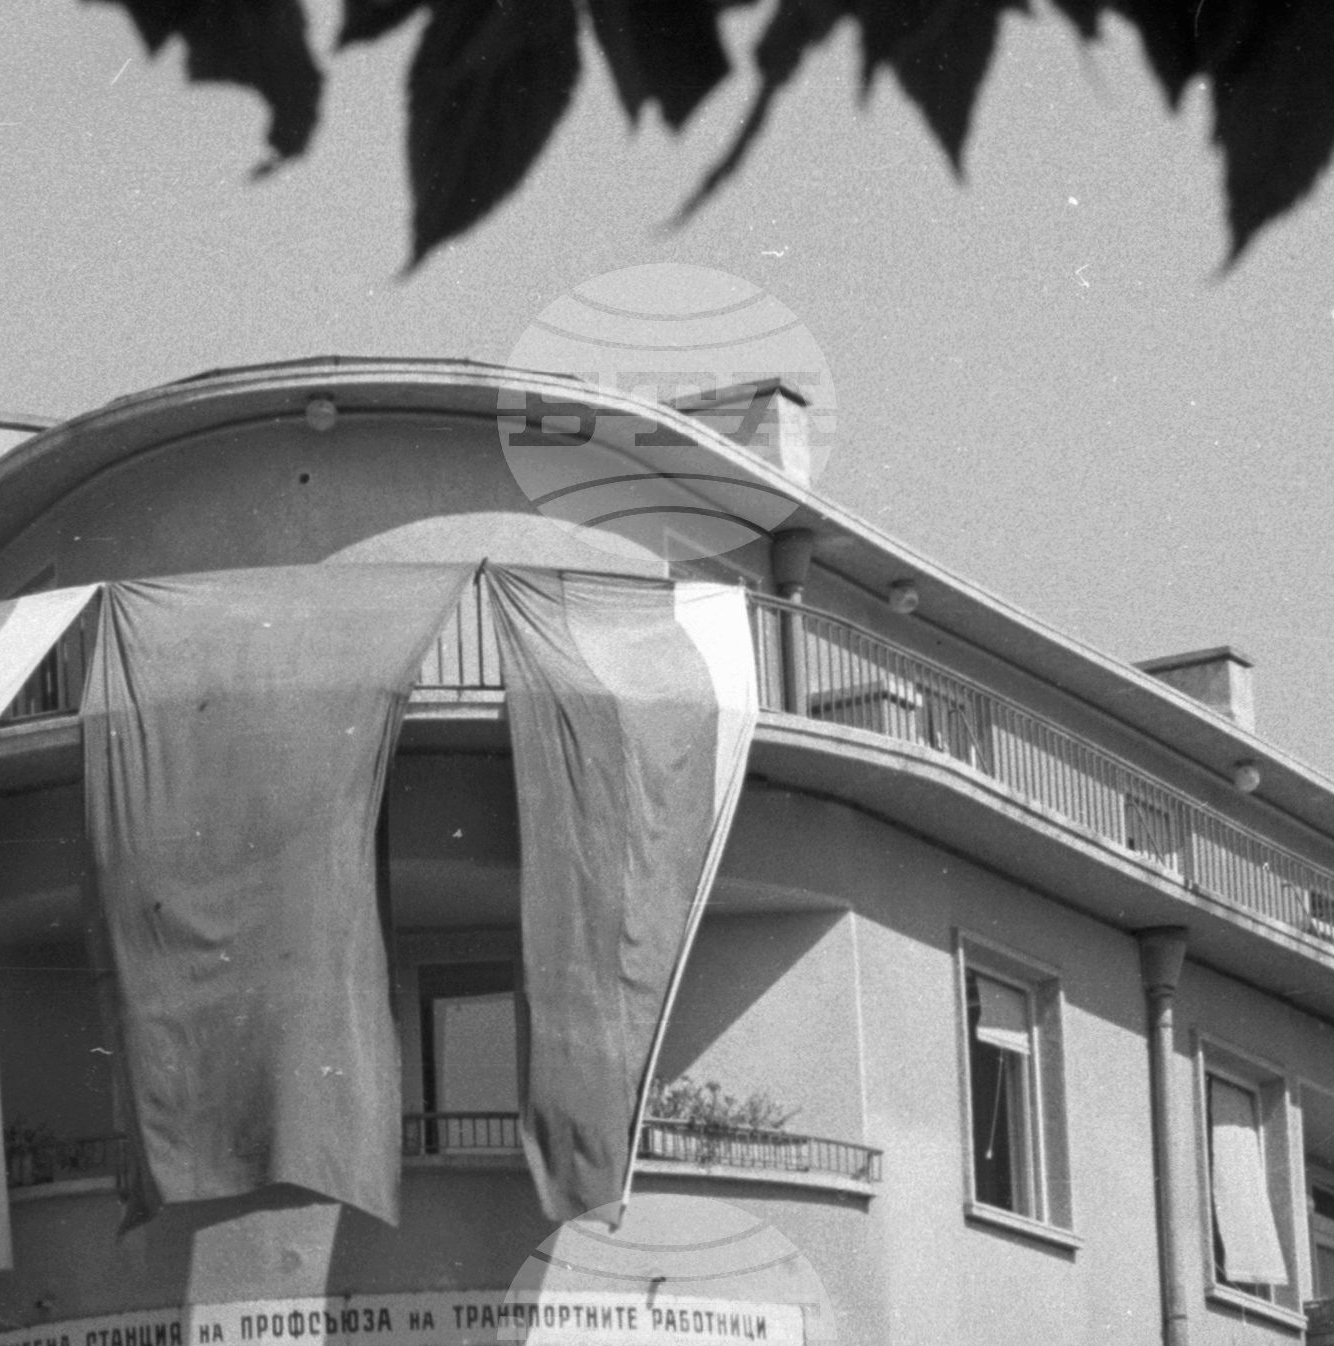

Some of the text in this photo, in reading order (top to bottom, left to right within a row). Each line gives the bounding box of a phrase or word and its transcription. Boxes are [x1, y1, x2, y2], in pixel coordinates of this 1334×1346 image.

[199, 1323, 225, 1345] НА
[240, 1305, 393, 1341] ПРОФСЪЮЗА
[409, 1312, 435, 1332] НА
[452, 1304, 639, 1332] ТРАНСПОРТНИТЕ
[651, 1306, 768, 1341] РАБОТНИЦИ
